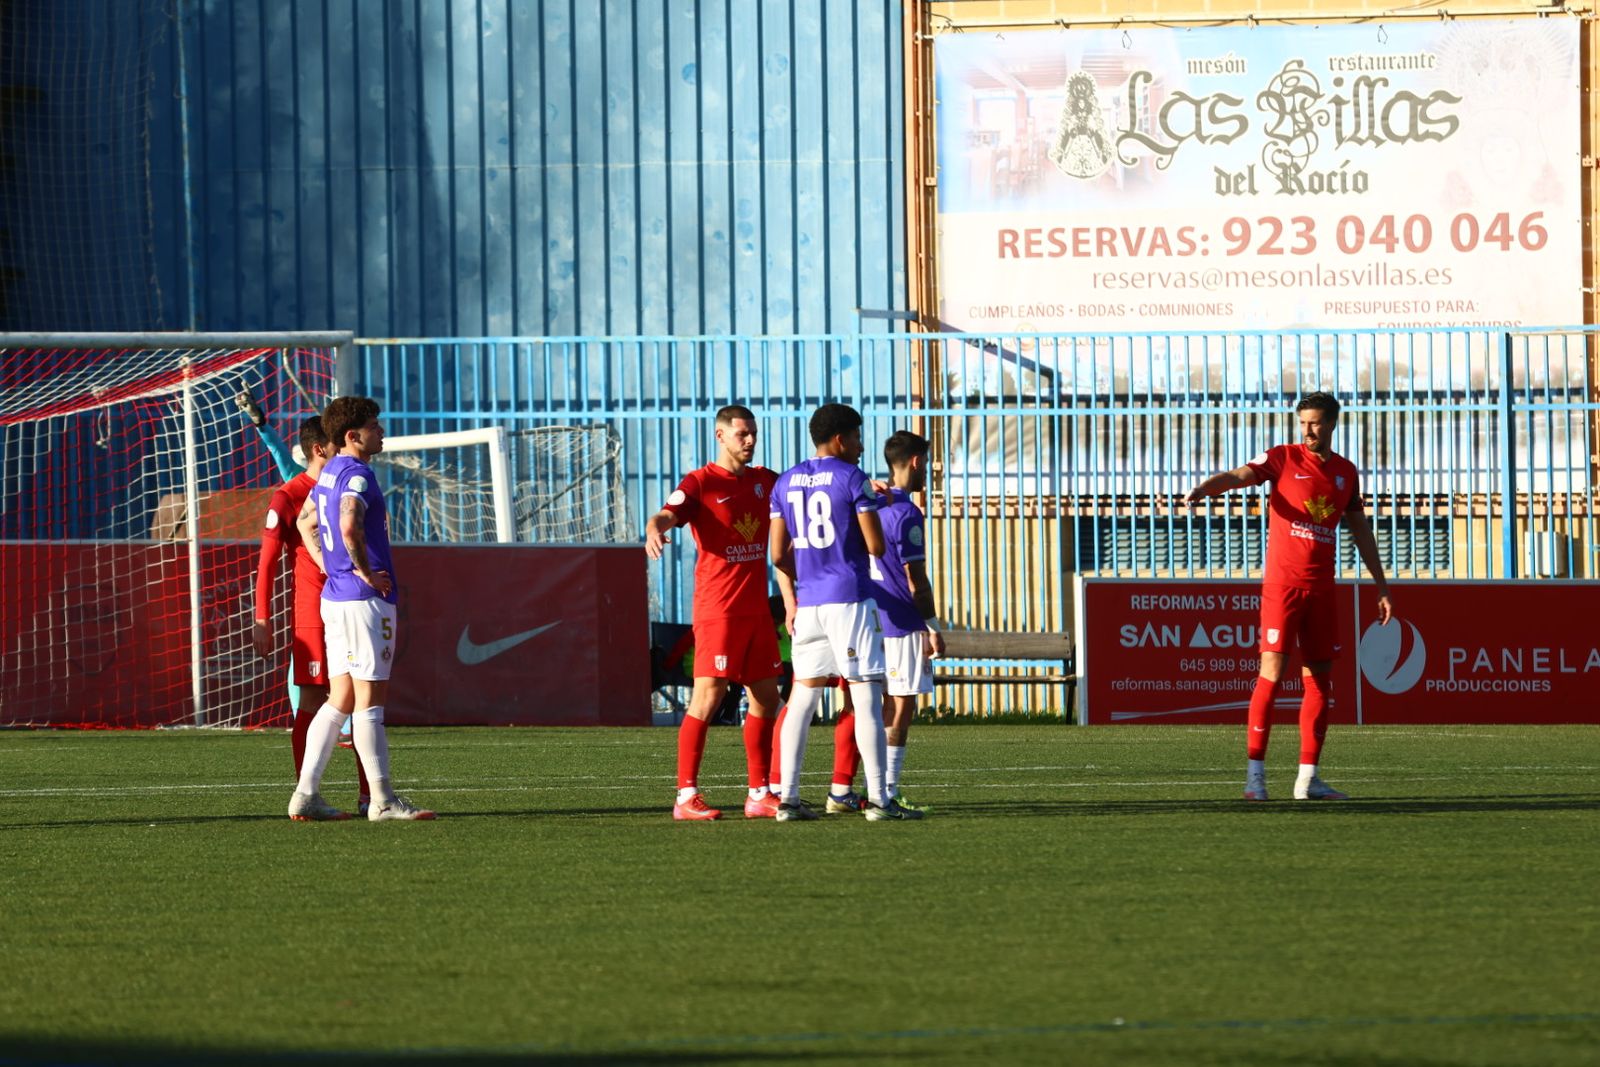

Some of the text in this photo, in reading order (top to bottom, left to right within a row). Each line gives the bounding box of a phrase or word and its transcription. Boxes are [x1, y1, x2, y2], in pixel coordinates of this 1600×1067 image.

[1187, 53, 1436, 74] mesón restaurante
[1116, 60, 1464, 170] Las Villas
[1213, 160, 1369, 196] del Rocío
[998, 211, 1548, 259] RESERVAS: 923 040 046
[1093, 262, 1453, 290] reservas@mesonlasvillas.es
[968, 302, 1234, 319] CUMPLEAÑOS BODAS COMUNIONES
[1324, 299, 1480, 315] PRESUPUESTO PARA:
[318, 493, 334, 552] 5
[786, 490, 836, 549] 18
[1131, 595, 1215, 610] REFORMAS
[1218, 595, 1228, 610] Y
[381, 618, 392, 641] 5
[1119, 622, 1181, 647] SAN
[1180, 658, 1206, 672] 645
[1210, 658, 1235, 672] 989
[1426, 679, 1551, 692] PRODUCCIONES
